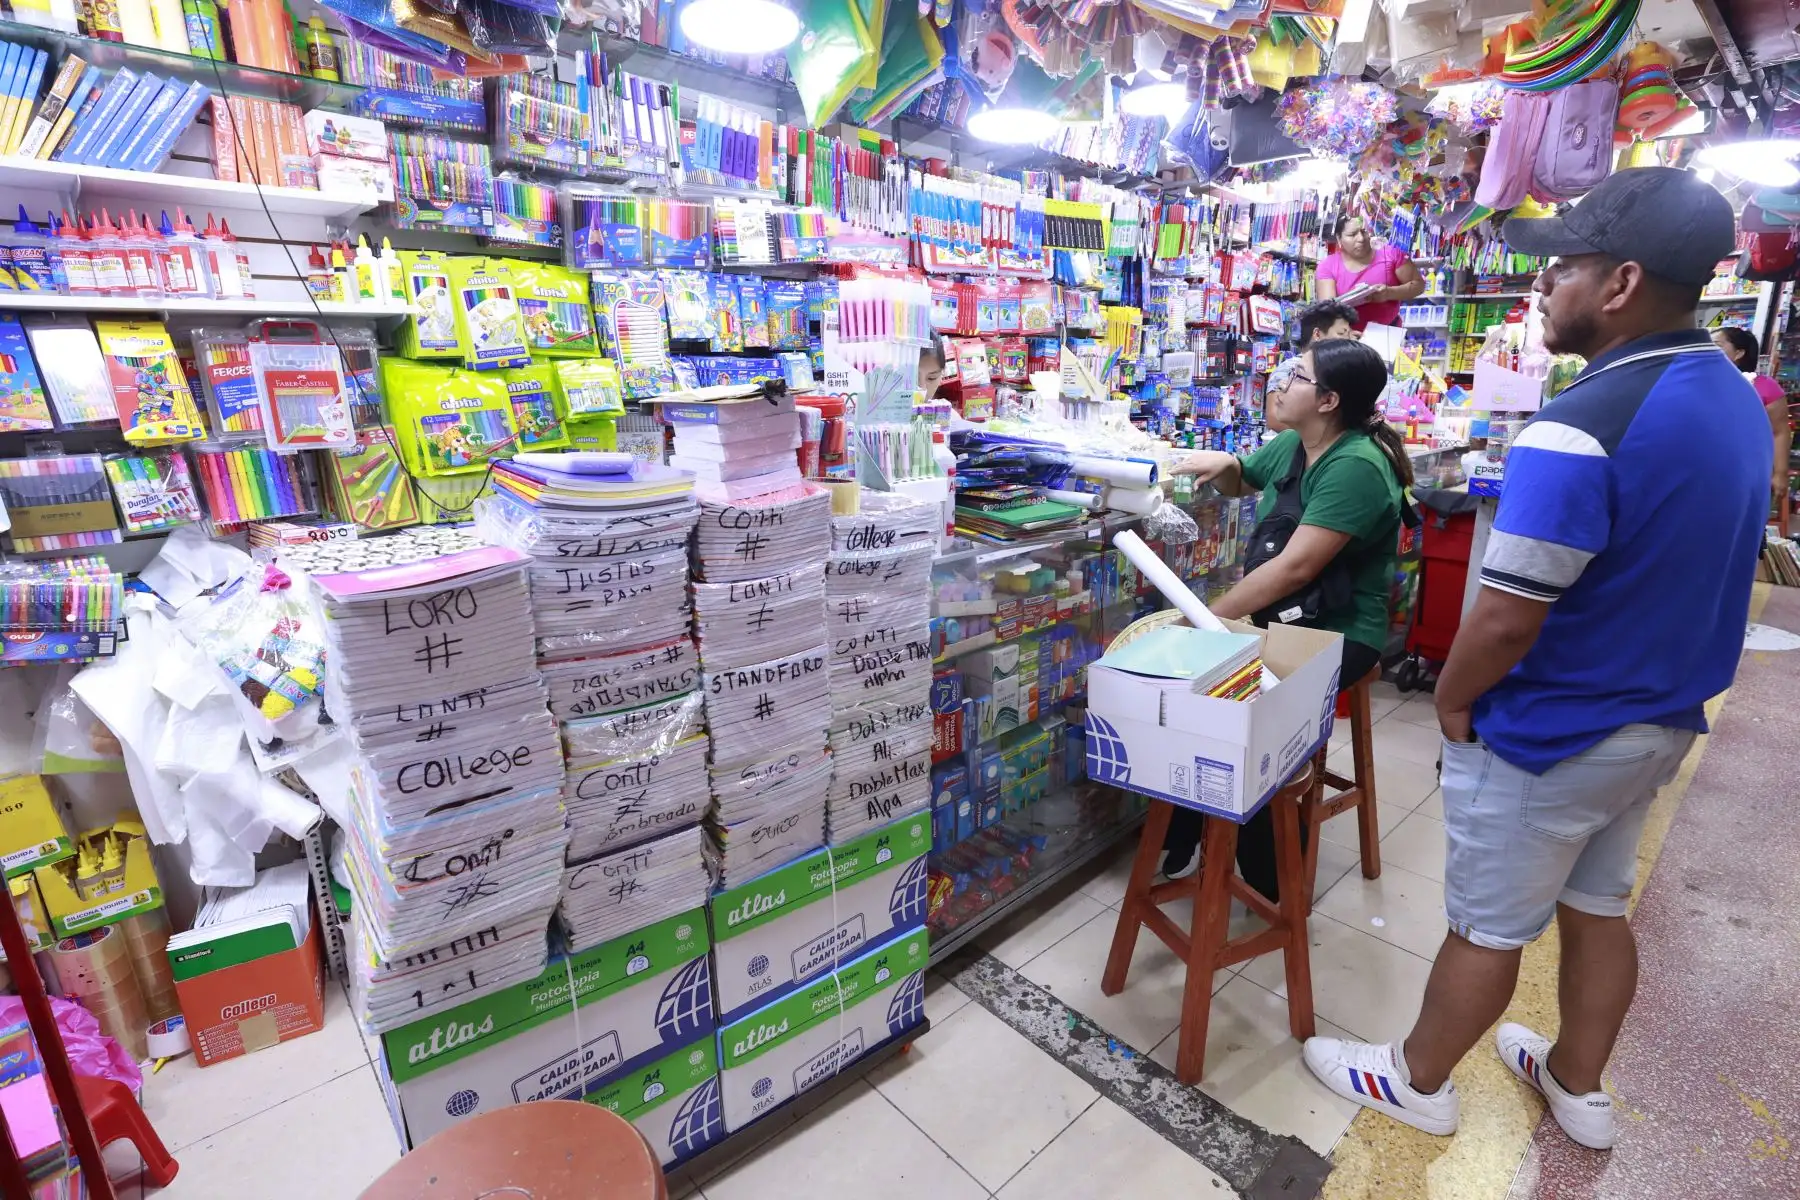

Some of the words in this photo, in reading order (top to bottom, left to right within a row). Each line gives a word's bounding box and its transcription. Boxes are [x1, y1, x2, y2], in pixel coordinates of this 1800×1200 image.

[466, 275, 499, 285] alpha
[603, 284, 616, 293] 50
[275, 379, 330, 387] FABER-CASTELL
[441, 397, 483, 410] alpha
[127, 494, 159, 509] Durafan
[383, 587, 478, 635] LORO
[876, 836, 890, 849] A4
[65, 908, 100, 923] SILICONA
[727, 888, 786, 926] atlas
[626, 940, 645, 957] A4
[875, 956, 888, 970] A4
[526, 980, 544, 991] Caja
[581, 958, 602, 970] hojas
[530, 970, 600, 1005] Fotocopia
[747, 976, 773, 994] ATLAS
[222, 994, 277, 1020] College
[408, 1014, 494, 1063] atlas
[733, 1017, 789, 1057] atlas
[643, 1069, 660, 1086] A4
[751, 1094, 775, 1114] ATLAS
